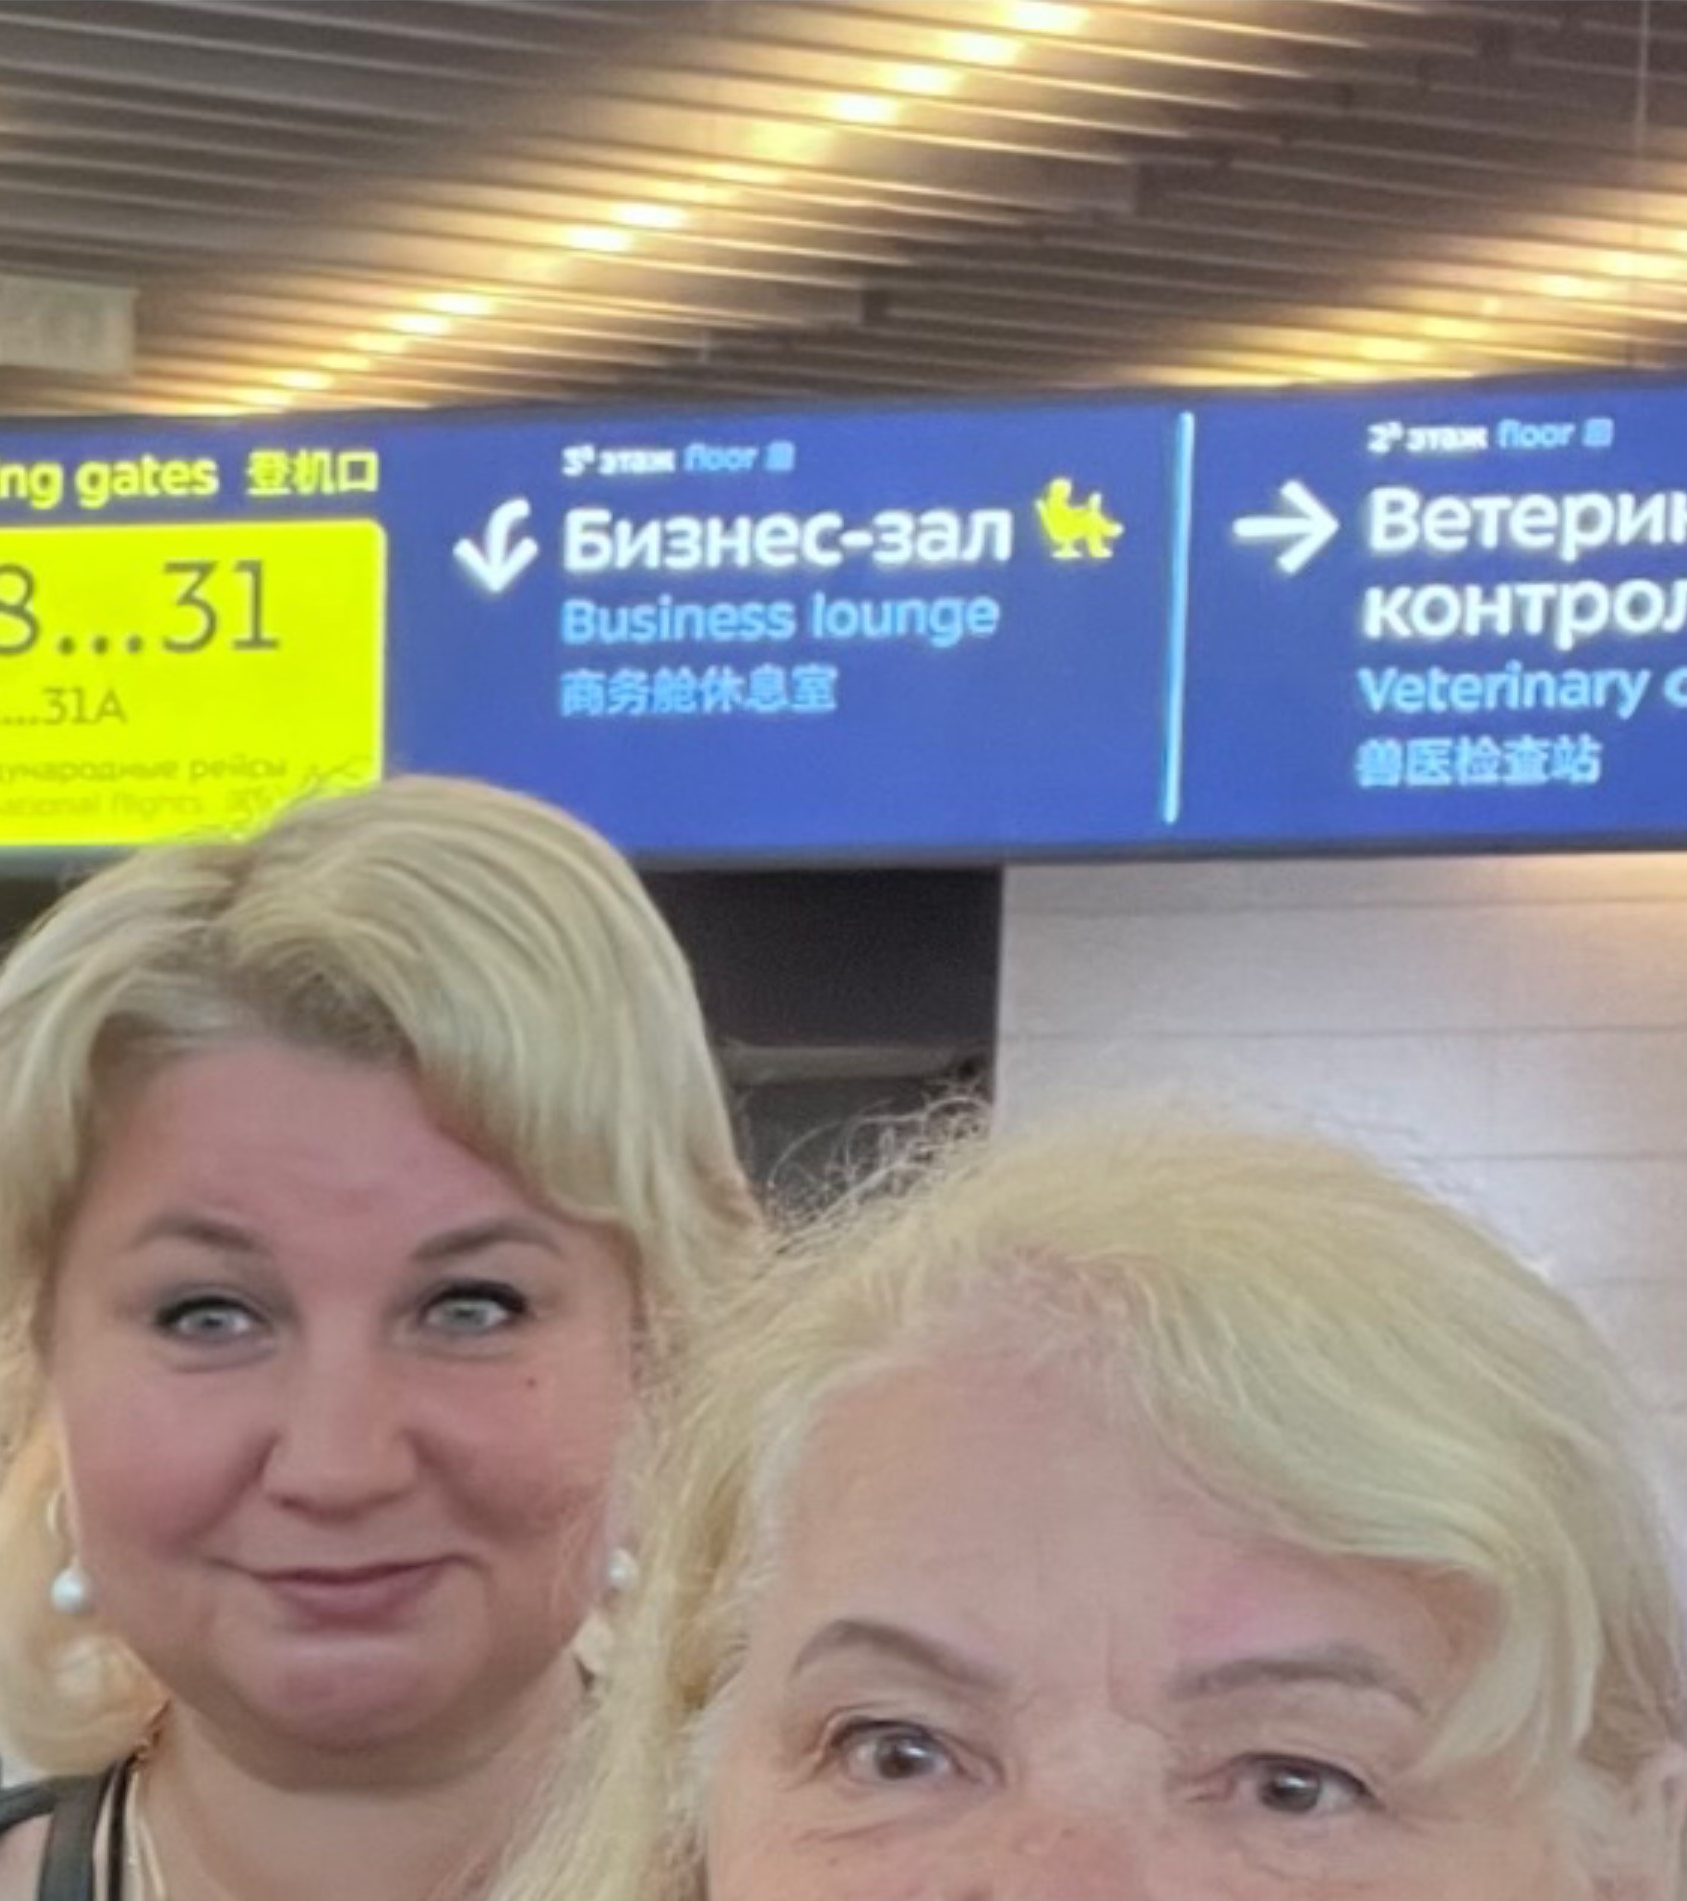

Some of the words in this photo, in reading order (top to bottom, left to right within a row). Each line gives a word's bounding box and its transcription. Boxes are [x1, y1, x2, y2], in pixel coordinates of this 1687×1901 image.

[1497, 419, 1575, 449] floor
[75, 458, 219, 510] gates
[246, 450, 379, 497] 登机口
[564, 506, 1014, 573] Бизнес-зал
[561, 594, 795, 646] Business
[813, 592, 1001, 649] lounge
[559, 664, 837, 718] 商务舱休息室
[1358, 659, 1649, 720] Veterinary
[189, 752, 287, 785] рейсы
[1355, 733, 1604, 789] 兽医检查站
